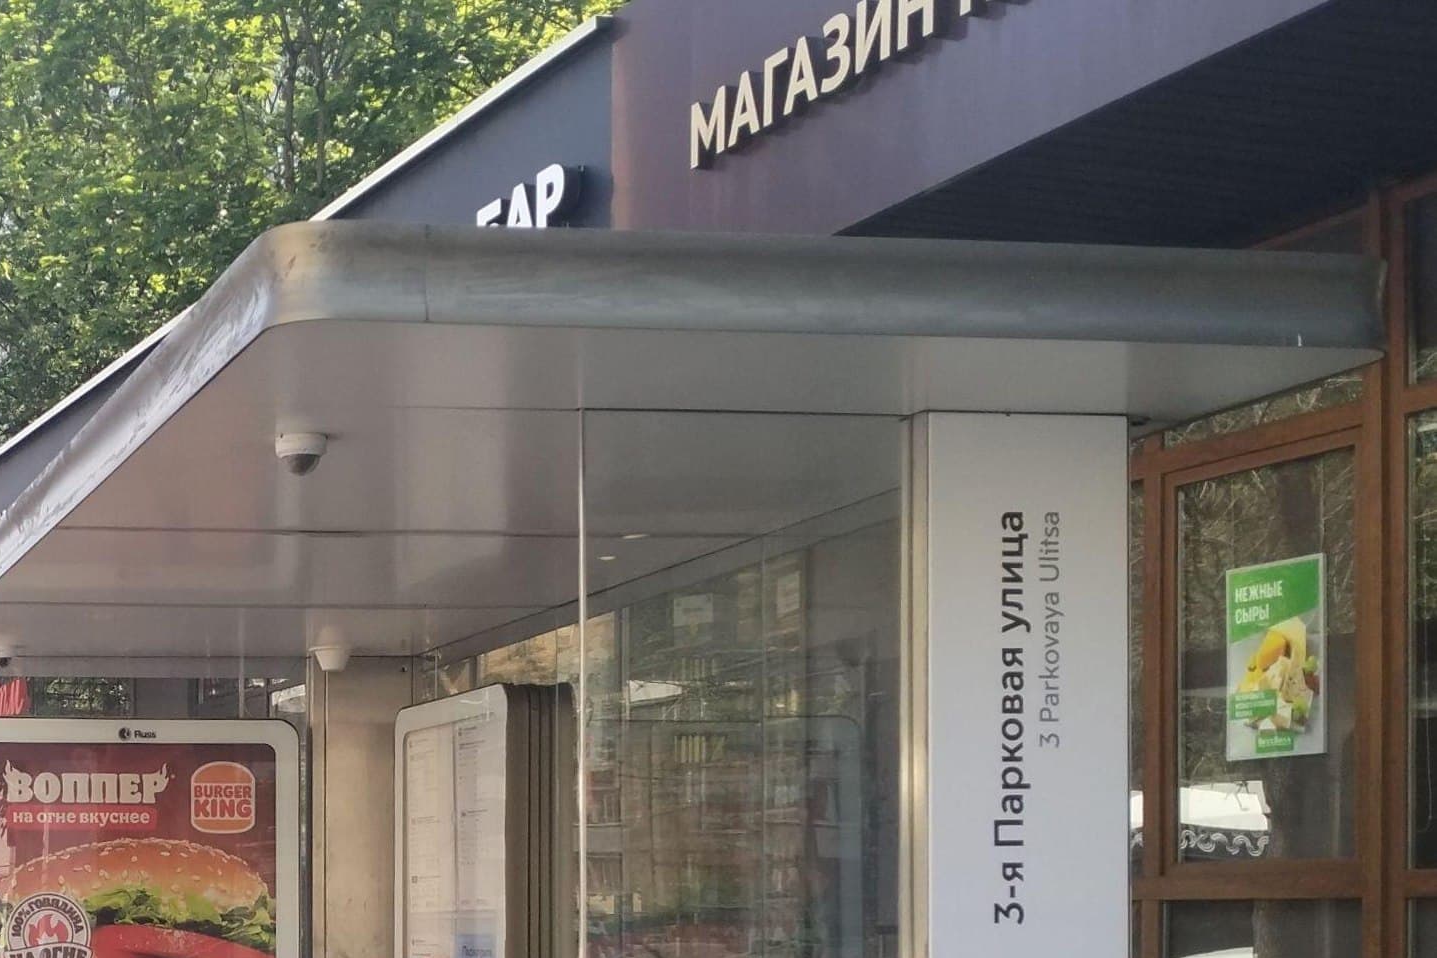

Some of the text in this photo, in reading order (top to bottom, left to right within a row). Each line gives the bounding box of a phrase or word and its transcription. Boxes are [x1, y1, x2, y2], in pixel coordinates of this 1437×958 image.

[1234, 578, 1284, 604] НЕЖНЫЕ
[1234, 604, 1271, 625] СЫРЫ
[1038, 510, 1067, 748] 3 Parkovaya Ulitsa
[993, 510, 1031, 926] 3-я Парковая улица
[4, 764, 169, 804] ВОППЕР
[193, 785, 252, 800] BURGER
[13, 811, 150, 827] на огне вкуснее
[193, 800, 252, 818] KING
[11, 897, 84, 937] 100% ГОВЯДИНА
